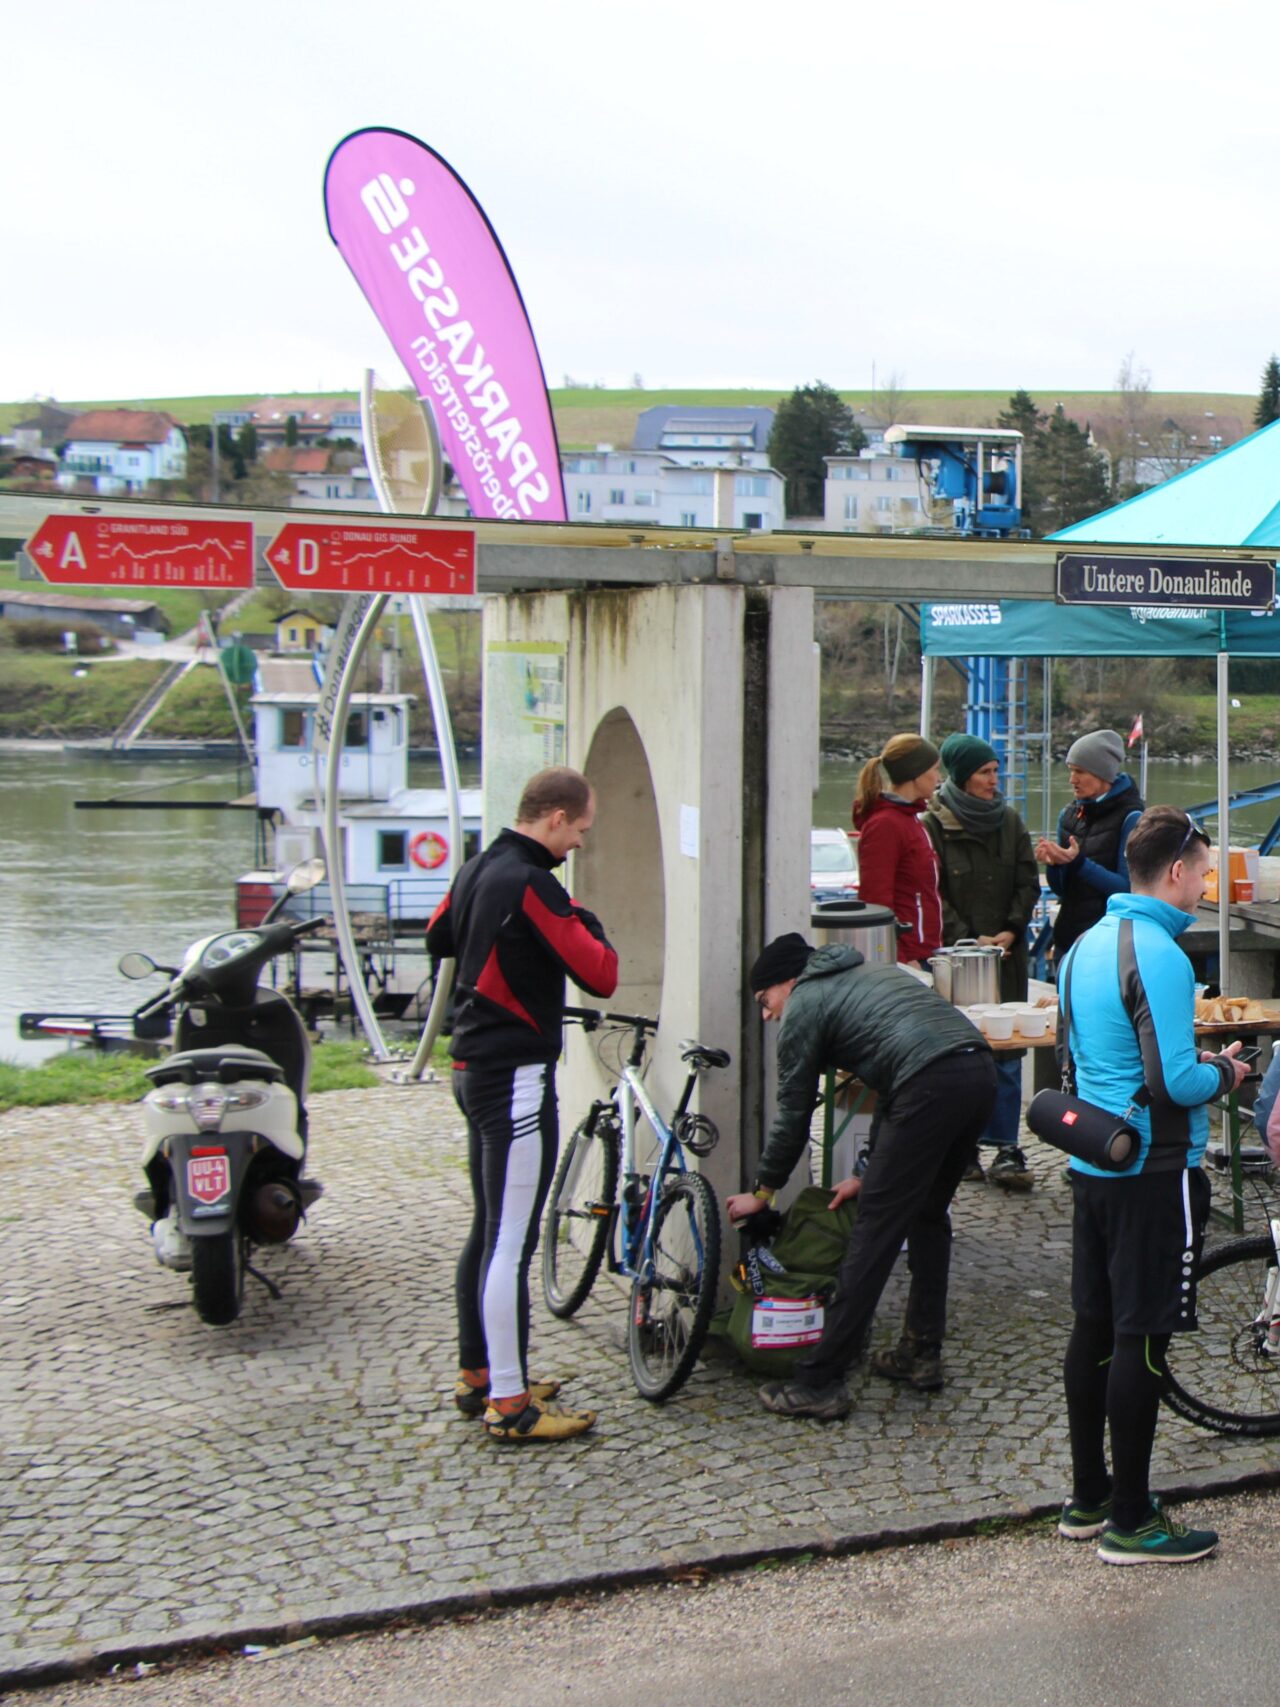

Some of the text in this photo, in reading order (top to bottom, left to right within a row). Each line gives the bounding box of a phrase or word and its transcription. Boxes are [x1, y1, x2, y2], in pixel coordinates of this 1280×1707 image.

[343, 531, 372, 542] DONAU
[389, 533, 418, 544] RUNDE
[59, 531, 88, 570] A
[298, 539, 319, 575] D
[1082, 565, 1252, 597] Untere Donaulände
[931, 604, 990, 626] SPARKASSE
[195, 1177, 224, 1191] VLT
[1203, 1416, 1242, 1432] RALPH
